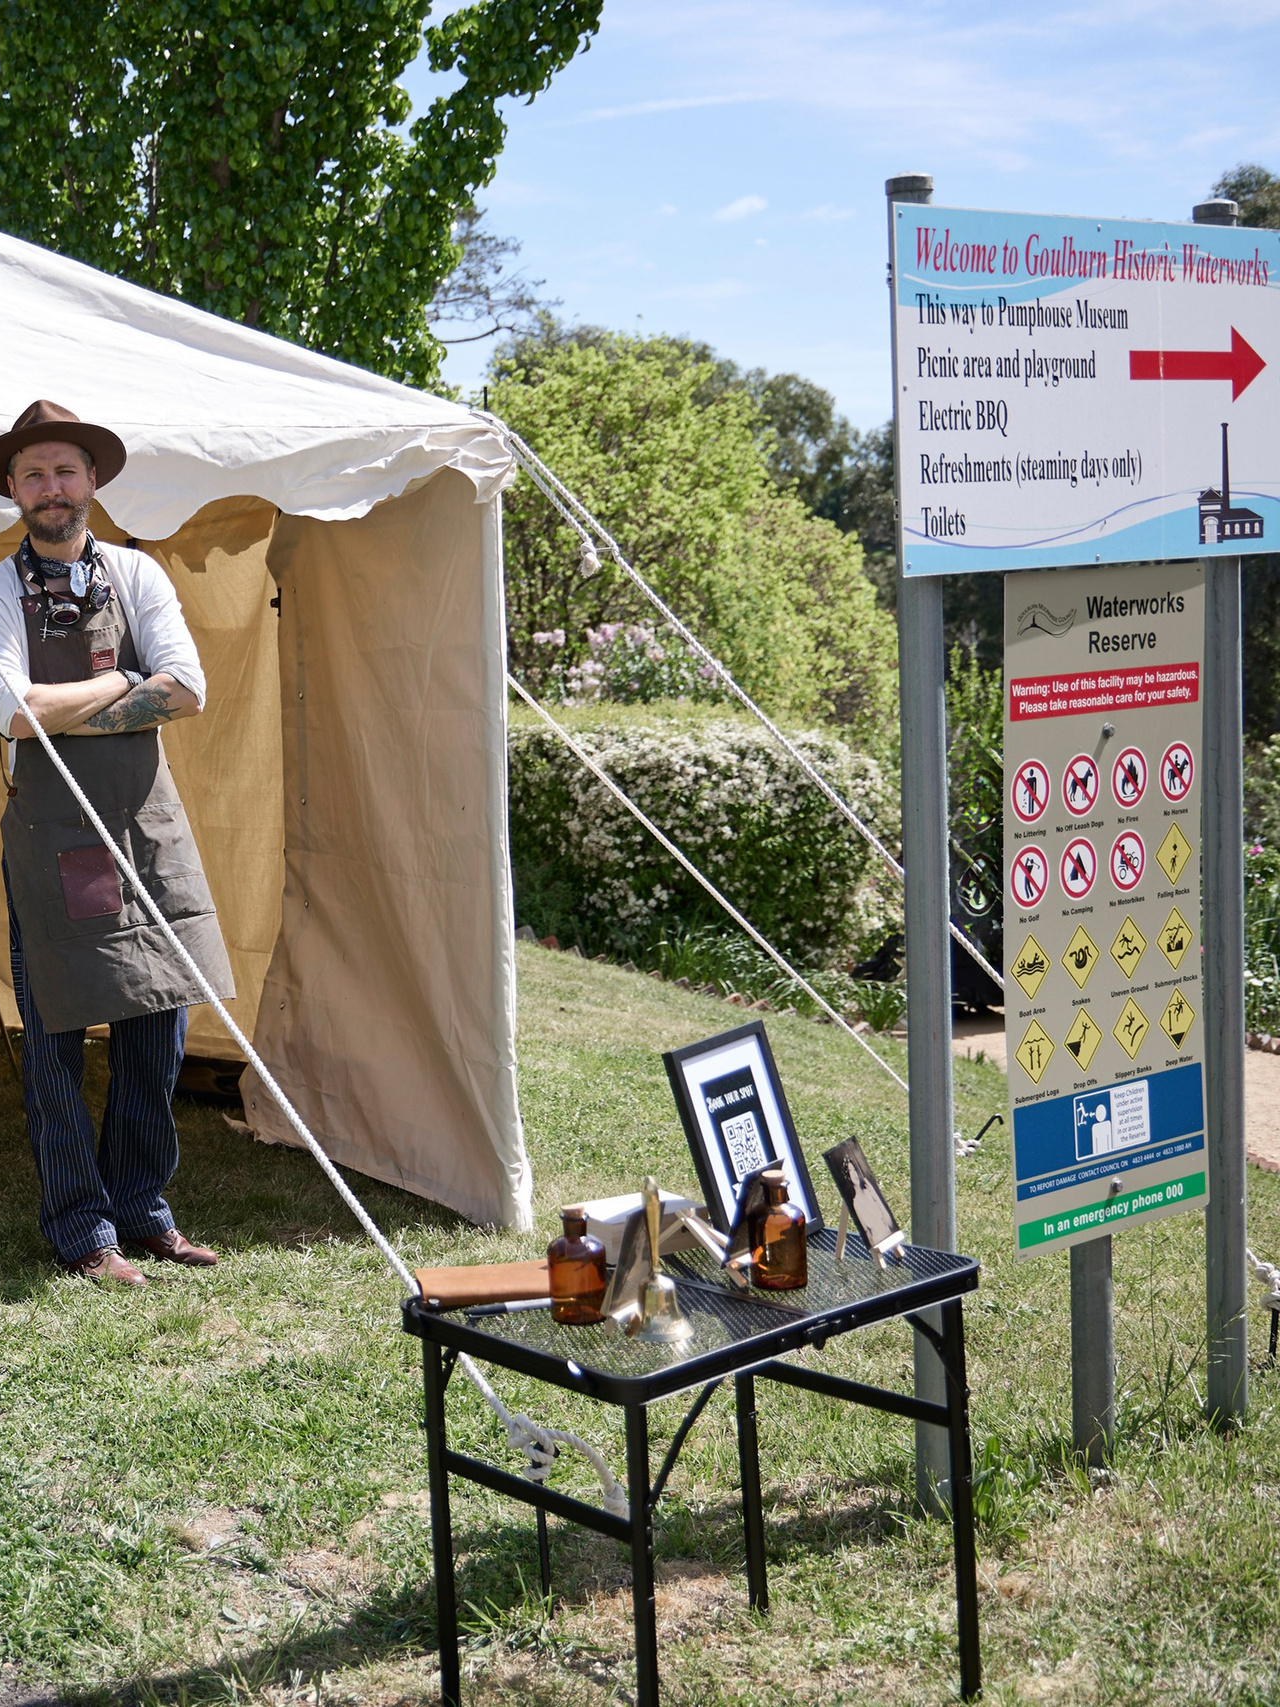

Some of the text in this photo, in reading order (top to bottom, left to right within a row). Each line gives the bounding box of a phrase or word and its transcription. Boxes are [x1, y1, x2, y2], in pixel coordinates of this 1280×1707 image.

[916, 227, 1269, 288] Welcome to Goulburn Historic Waterworks
[916, 294, 1129, 335] This way to Pumphouse Museum
[918, 347, 1096, 387] Picnic area and playground
[919, 400, 1008, 437] Electric BBQ
[921, 449, 1142, 489] Refreshments (steaming days only)
[922, 507, 966, 538] Toilets
[1087, 592, 1184, 619] Waterworks
[1089, 632, 1157, 653] Reserve
[1012, 669, 1198, 698] Warning: Use of this facility may be hazardous.
[1020, 687, 1191, 714] Please take reasonable care for your safety.
[1074, 822, 1089, 830] Leash
[1023, 829, 1046, 838] Littering
[1118, 896, 1145, 906] Motorbikes
[1158, 890, 1173, 899] Falling
[1071, 906, 1093, 915] Camping
[1028, 914, 1039, 922] Golf
[1155, 974, 1197, 988] Submerged Rocks
[1111, 984, 1149, 997] Uneven Ground
[1072, 997, 1091, 1006] Snakes
[1033, 1007, 1046, 1015] Area
[1166, 1055, 1193, 1067] Deep Water
[1115, 1065, 1152, 1079] Slippery Banks
[1074, 1082, 1086, 1090] Drop
[1015, 1089, 1059, 1104] Submerged Logs
[1037, 1181, 1055, 1191] REPORT
[1056, 1174, 1076, 1186] DAMAGE
[1078, 1168, 1099, 1180] CONTACT
[1100, 1163, 1120, 1173] COUNCIL
[1044, 1183, 1183, 1235] In an emergency phone 000
